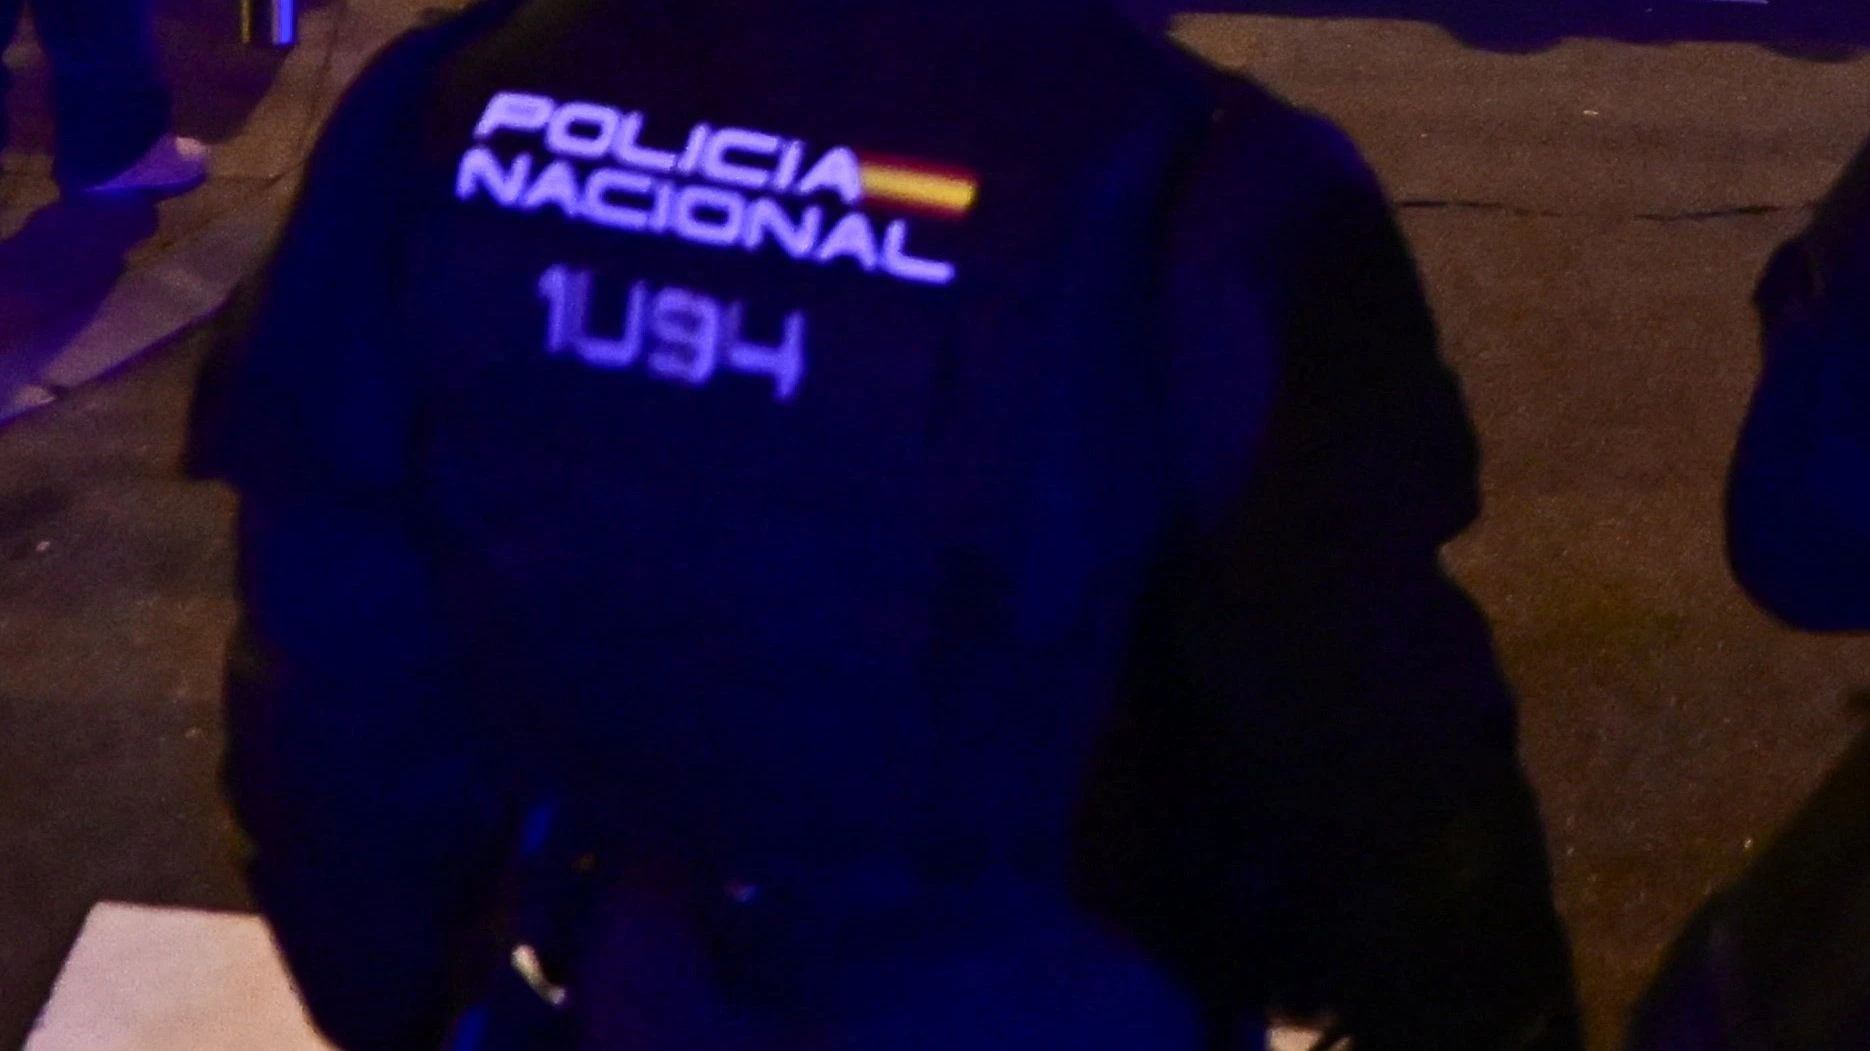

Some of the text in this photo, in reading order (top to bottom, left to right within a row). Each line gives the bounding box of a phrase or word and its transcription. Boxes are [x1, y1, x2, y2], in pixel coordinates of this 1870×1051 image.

[455, 146, 957, 286] NACIONAL
[473, 91, 862, 205] POLICIA
[537, 264, 808, 402] 1U94
